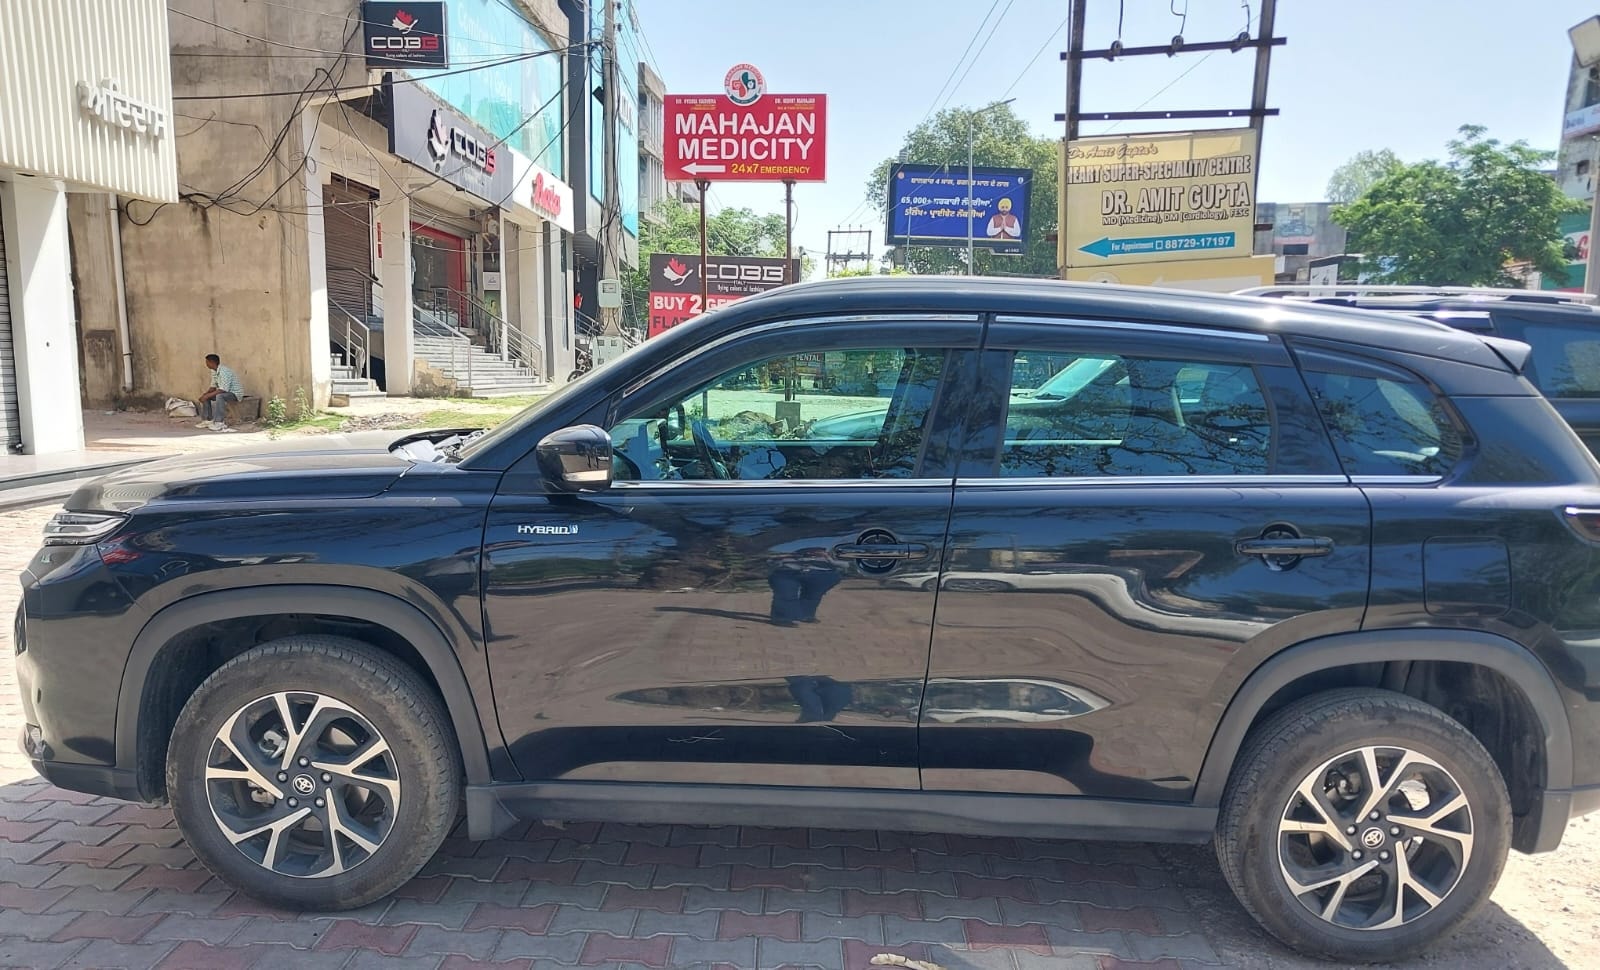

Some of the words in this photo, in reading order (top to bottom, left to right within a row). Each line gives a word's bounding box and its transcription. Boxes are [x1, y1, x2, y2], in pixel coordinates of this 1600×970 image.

[370, 36, 439, 49] COBB
[675, 112, 816, 135] MAHAJAN
[452, 126, 496, 175] COBB
[678, 137, 813, 160] MEDICITY
[731, 163, 760, 174] 24x7
[760, 166, 810, 174] EMERGENCY
[1102, 160, 1208, 182] SUPER-SPECIALITY
[1209, 155, 1252, 176] CENTRE
[1102, 190, 1132, 215] DR.
[1136, 186, 1184, 214] AMIT
[1188, 182, 1251, 210] GUPTA
[1102, 216, 1117, 226] MD
[1164, 213, 1178, 222] DM
[1165, 236, 1231, 249] 88729-17197
[698, 263, 784, 282] COBB
[653, 296, 686, 310] BUY
[689, 295, 702, 314] 2
[518, 525, 570, 534] HYBRID
